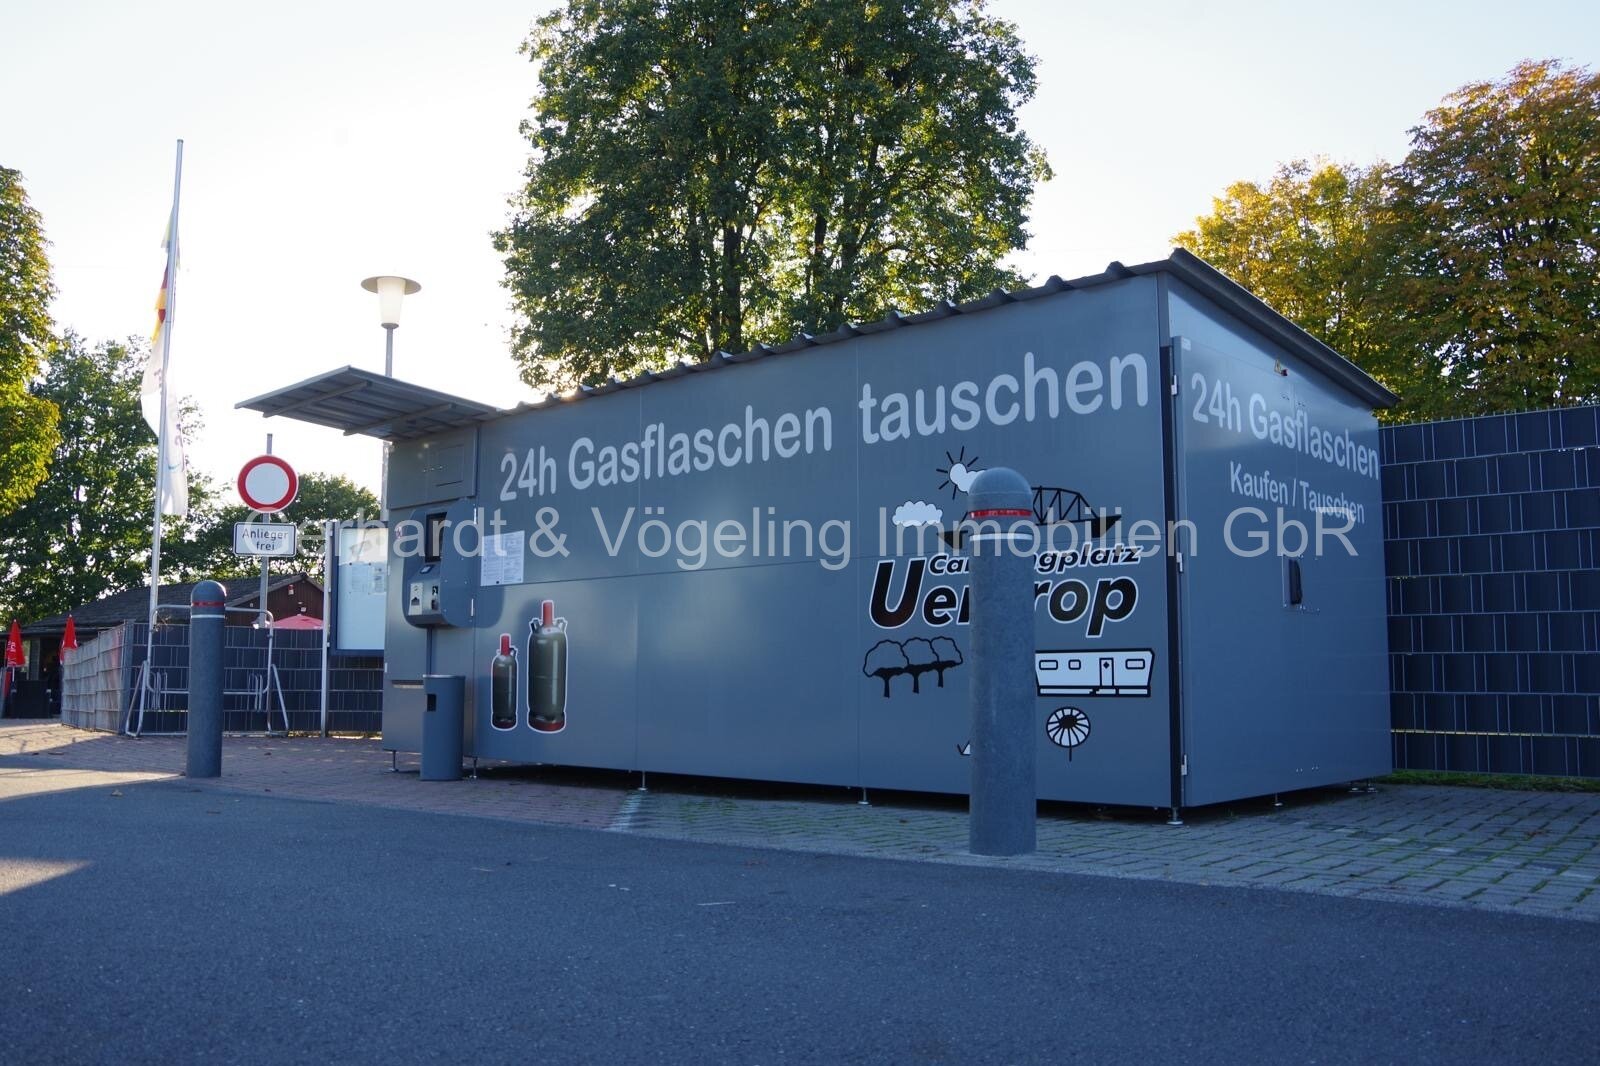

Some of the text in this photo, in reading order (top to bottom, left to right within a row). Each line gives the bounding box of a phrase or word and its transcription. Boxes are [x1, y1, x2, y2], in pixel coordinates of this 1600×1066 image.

[500, 352, 1148, 501] 24h Gasflaschen tauschen
[1191, 372, 1379, 480] 24h Gasflaschen
[1230, 461, 1365, 524] Kaufen / Tauschen
[241, 528, 288, 541] Anlieger
[256, 540, 275, 551] frei
[928, 541, 1144, 575] Cagplatz
[868, 557, 1139, 638] Uerop
